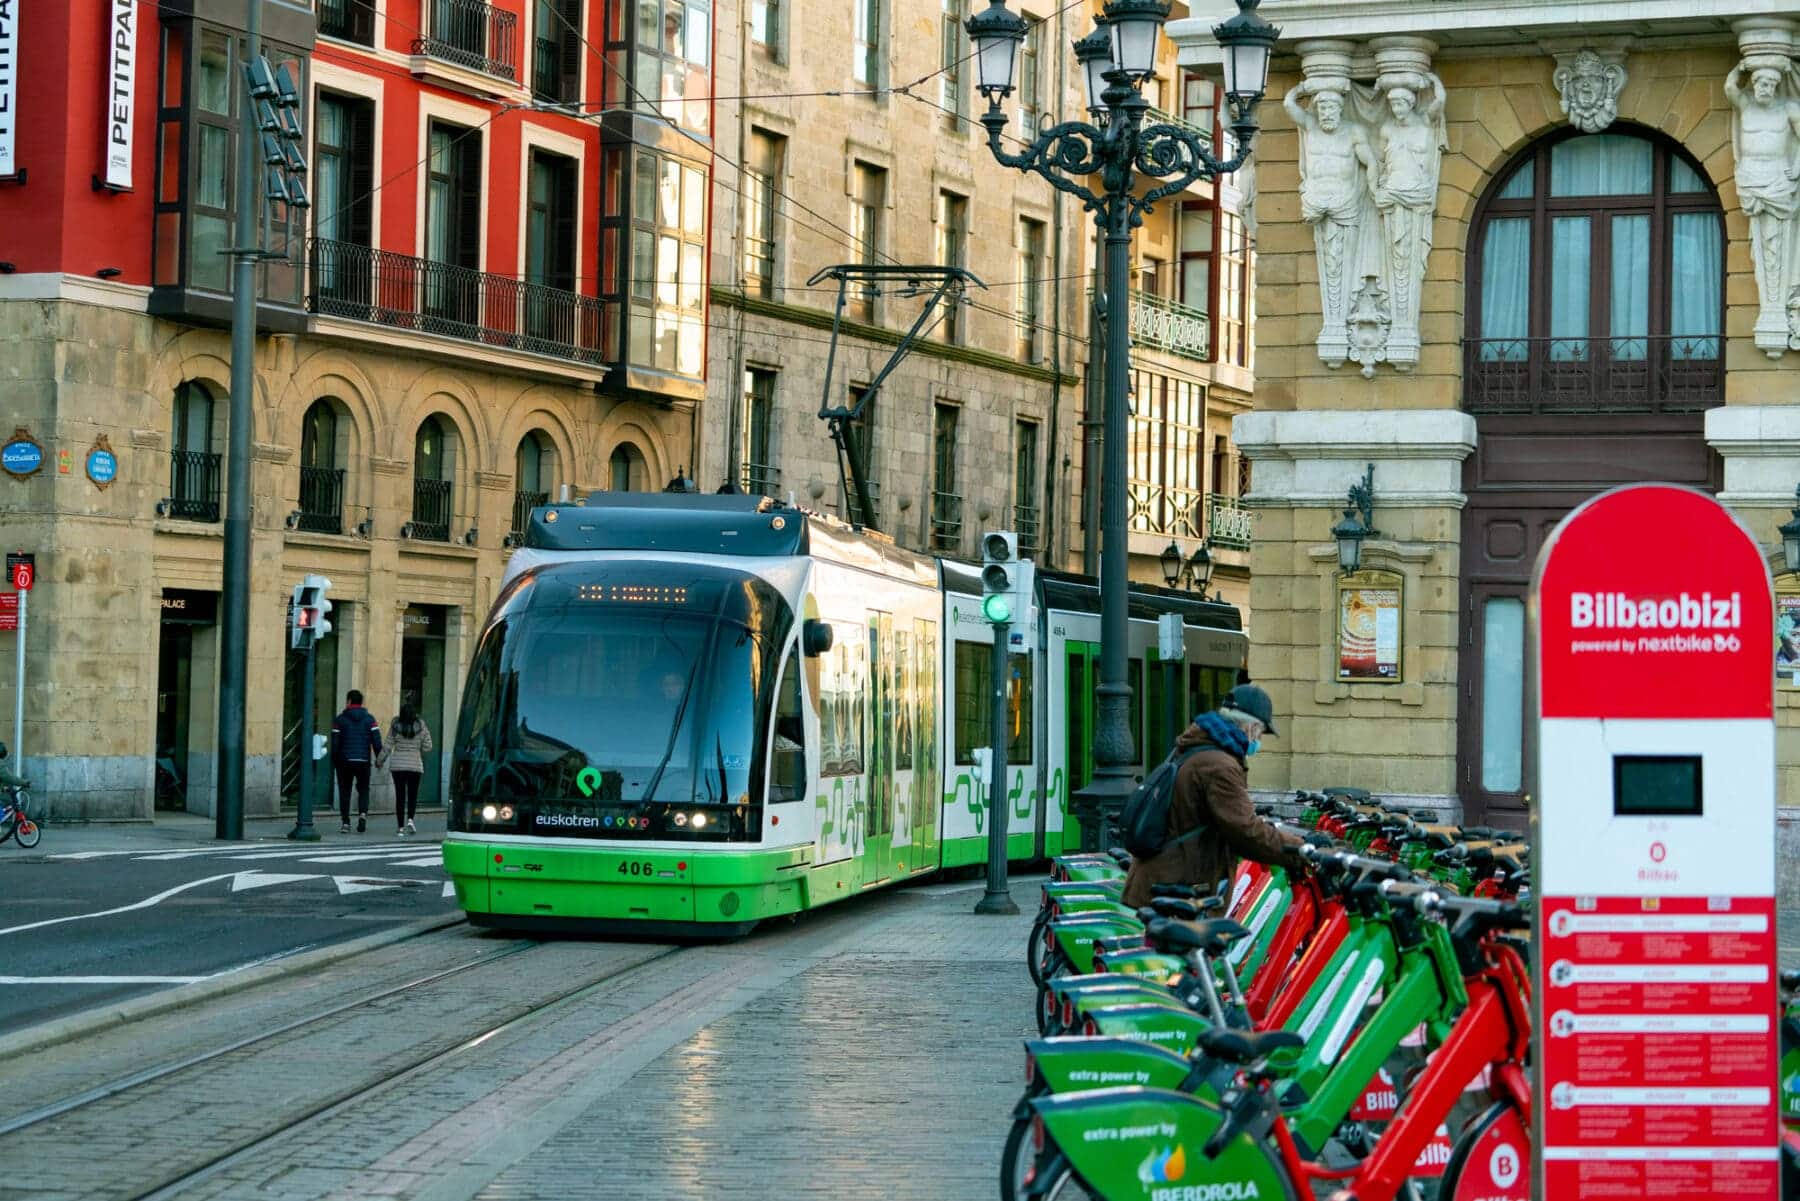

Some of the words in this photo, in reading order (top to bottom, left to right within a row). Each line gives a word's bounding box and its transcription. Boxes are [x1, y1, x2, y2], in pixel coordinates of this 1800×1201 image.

[1571, 592, 1741, 629] Bilbaobizi
[1571, 639, 1620, 654] powered
[1622, 638, 1637, 655] by
[1638, 633, 1712, 653] nextbike
[536, 813, 600, 828] euskotren
[618, 860, 653, 876] 406
[1149, 1031, 1175, 1041] power
[1175, 1029, 1187, 1041] by
[1069, 1071, 1099, 1082] extra
[1100, 1071, 1134, 1083] power
[1136, 1069, 1150, 1083] by
[1083, 1126, 1118, 1141] extra
[1119, 1125, 1158, 1141] power
[1158, 1122, 1177, 1138] by
[1498, 1155, 1513, 1177] B
[1151, 1180, 1259, 1201] IBERDROLA
